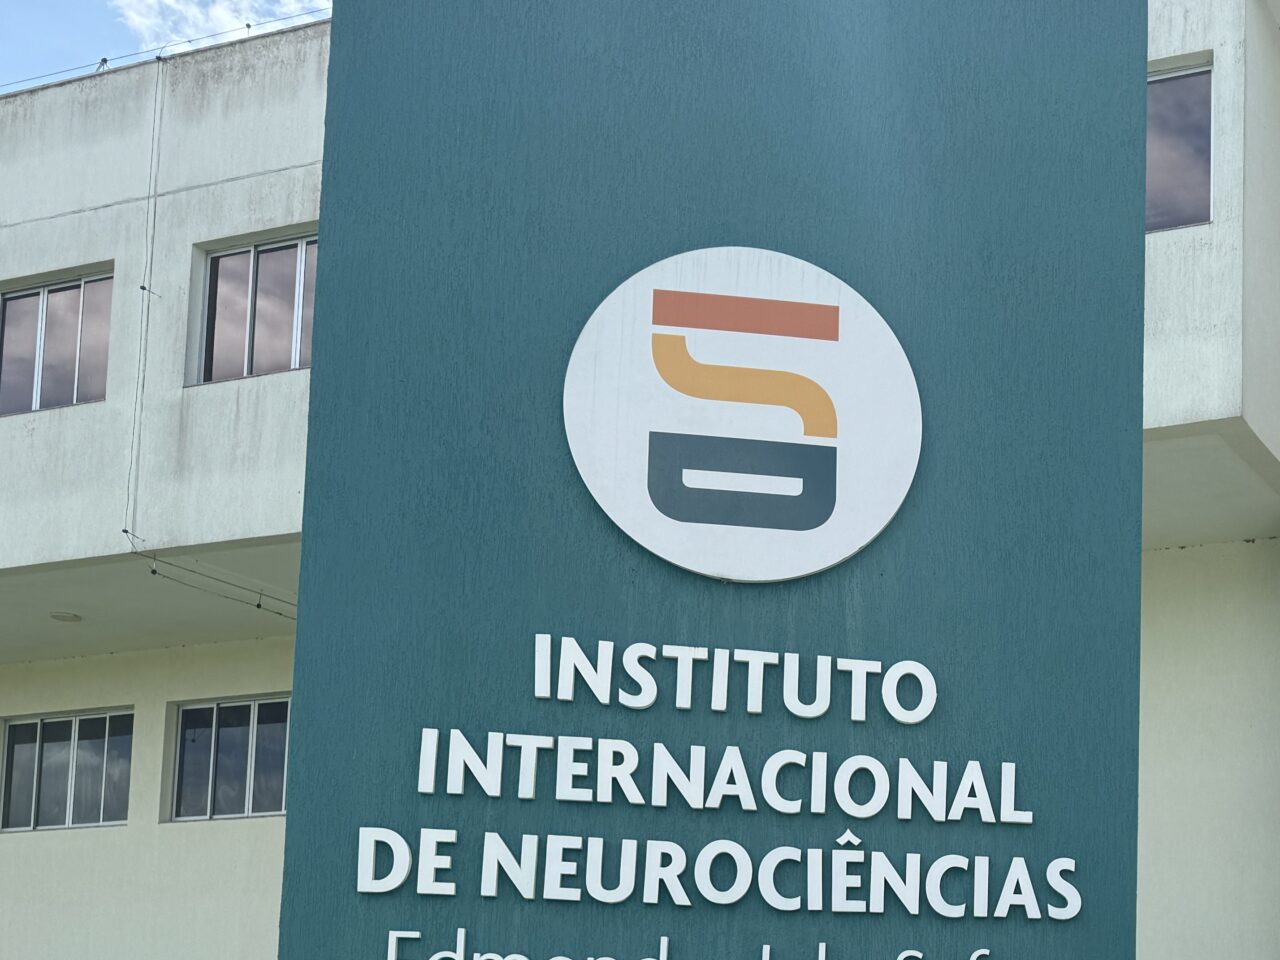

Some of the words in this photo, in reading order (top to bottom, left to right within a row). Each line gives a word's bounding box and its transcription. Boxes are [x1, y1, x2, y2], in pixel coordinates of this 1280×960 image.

[534, 633, 938, 725] INSTITUTO
[416, 727, 1034, 824] INTERNACIONAL
[355, 826, 457, 896] DE
[480, 828, 1083, 921] NEUROCIÊNCIAS
